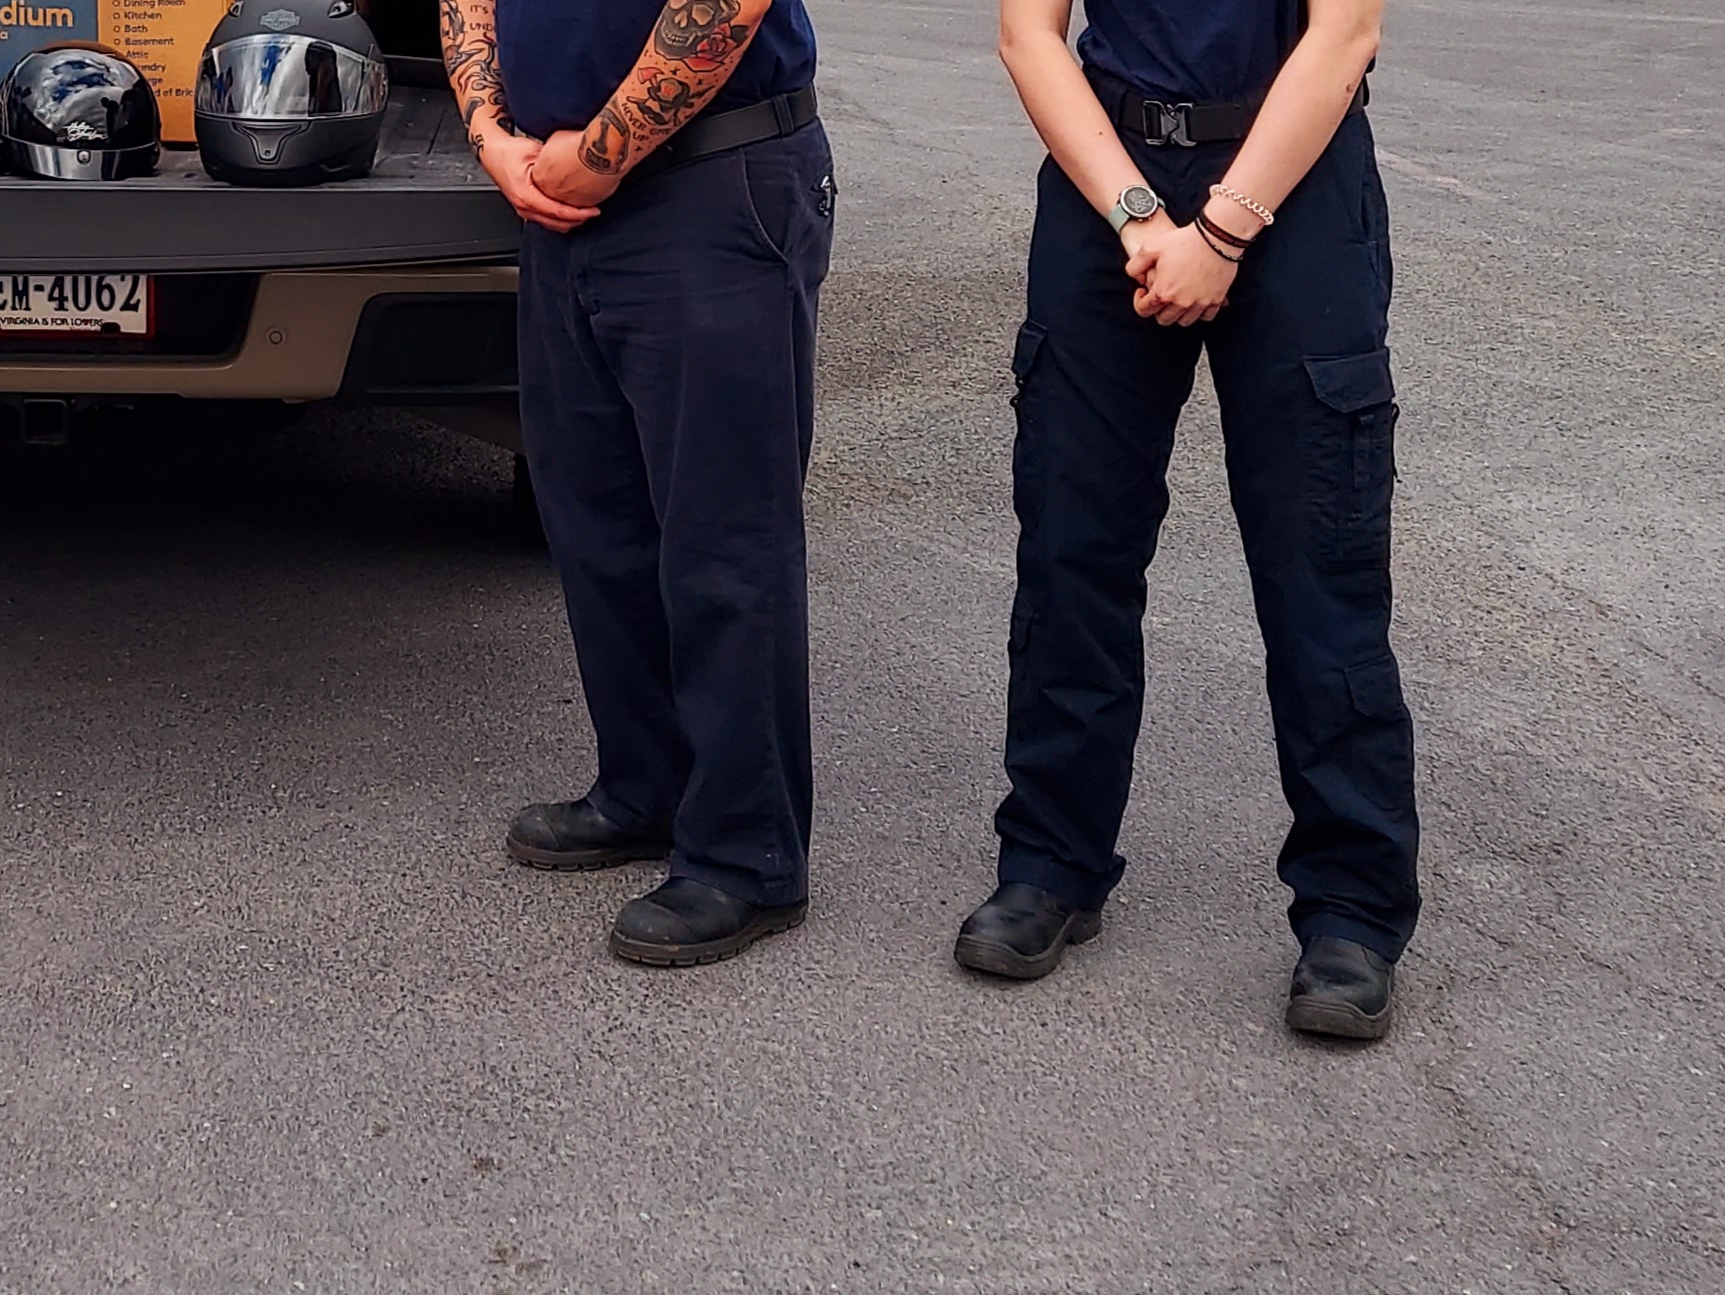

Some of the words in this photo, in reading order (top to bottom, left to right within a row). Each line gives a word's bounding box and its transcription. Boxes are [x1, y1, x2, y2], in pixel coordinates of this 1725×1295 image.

[124, 11, 162, 20] Kitchen
[124, 24, 148, 33] Bath
[125, 37, 175, 46] Basement
[126, 50, 149, 59] Attic
[0, 317, 40, 326] VIRGINIA
[41, 317, 49, 326] IS
[50, 317, 68, 326] FOR
